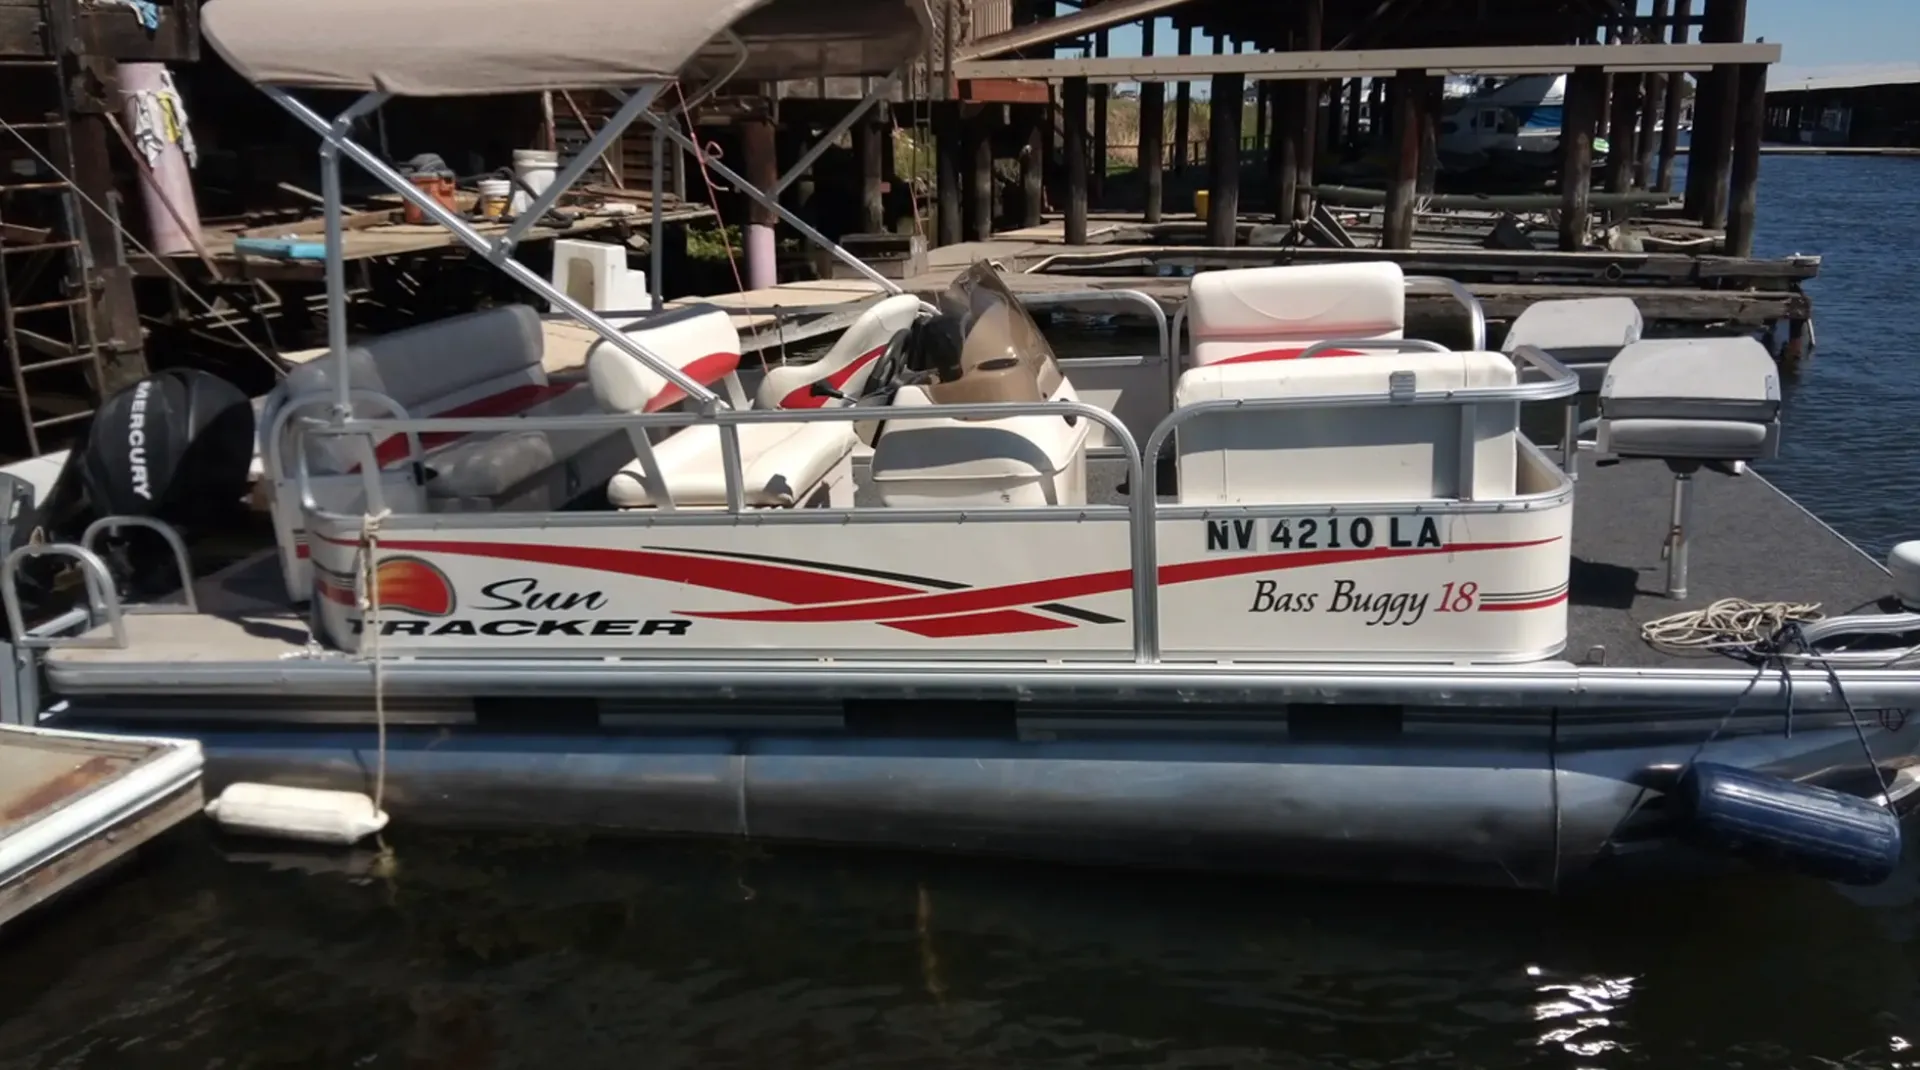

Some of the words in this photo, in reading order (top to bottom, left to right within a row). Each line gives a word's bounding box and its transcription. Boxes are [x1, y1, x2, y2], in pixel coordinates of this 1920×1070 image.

[128, 380, 152, 500] MERCURY
[1207, 519, 1254, 550] NV
[1270, 517, 1374, 549] 4210
[1390, 516, 1441, 548] LA
[467, 577, 608, 611] Sun
[1249, 579, 1318, 612] Bass
[1326, 579, 1429, 626] Buggy
[1434, 581, 1478, 612] 18
